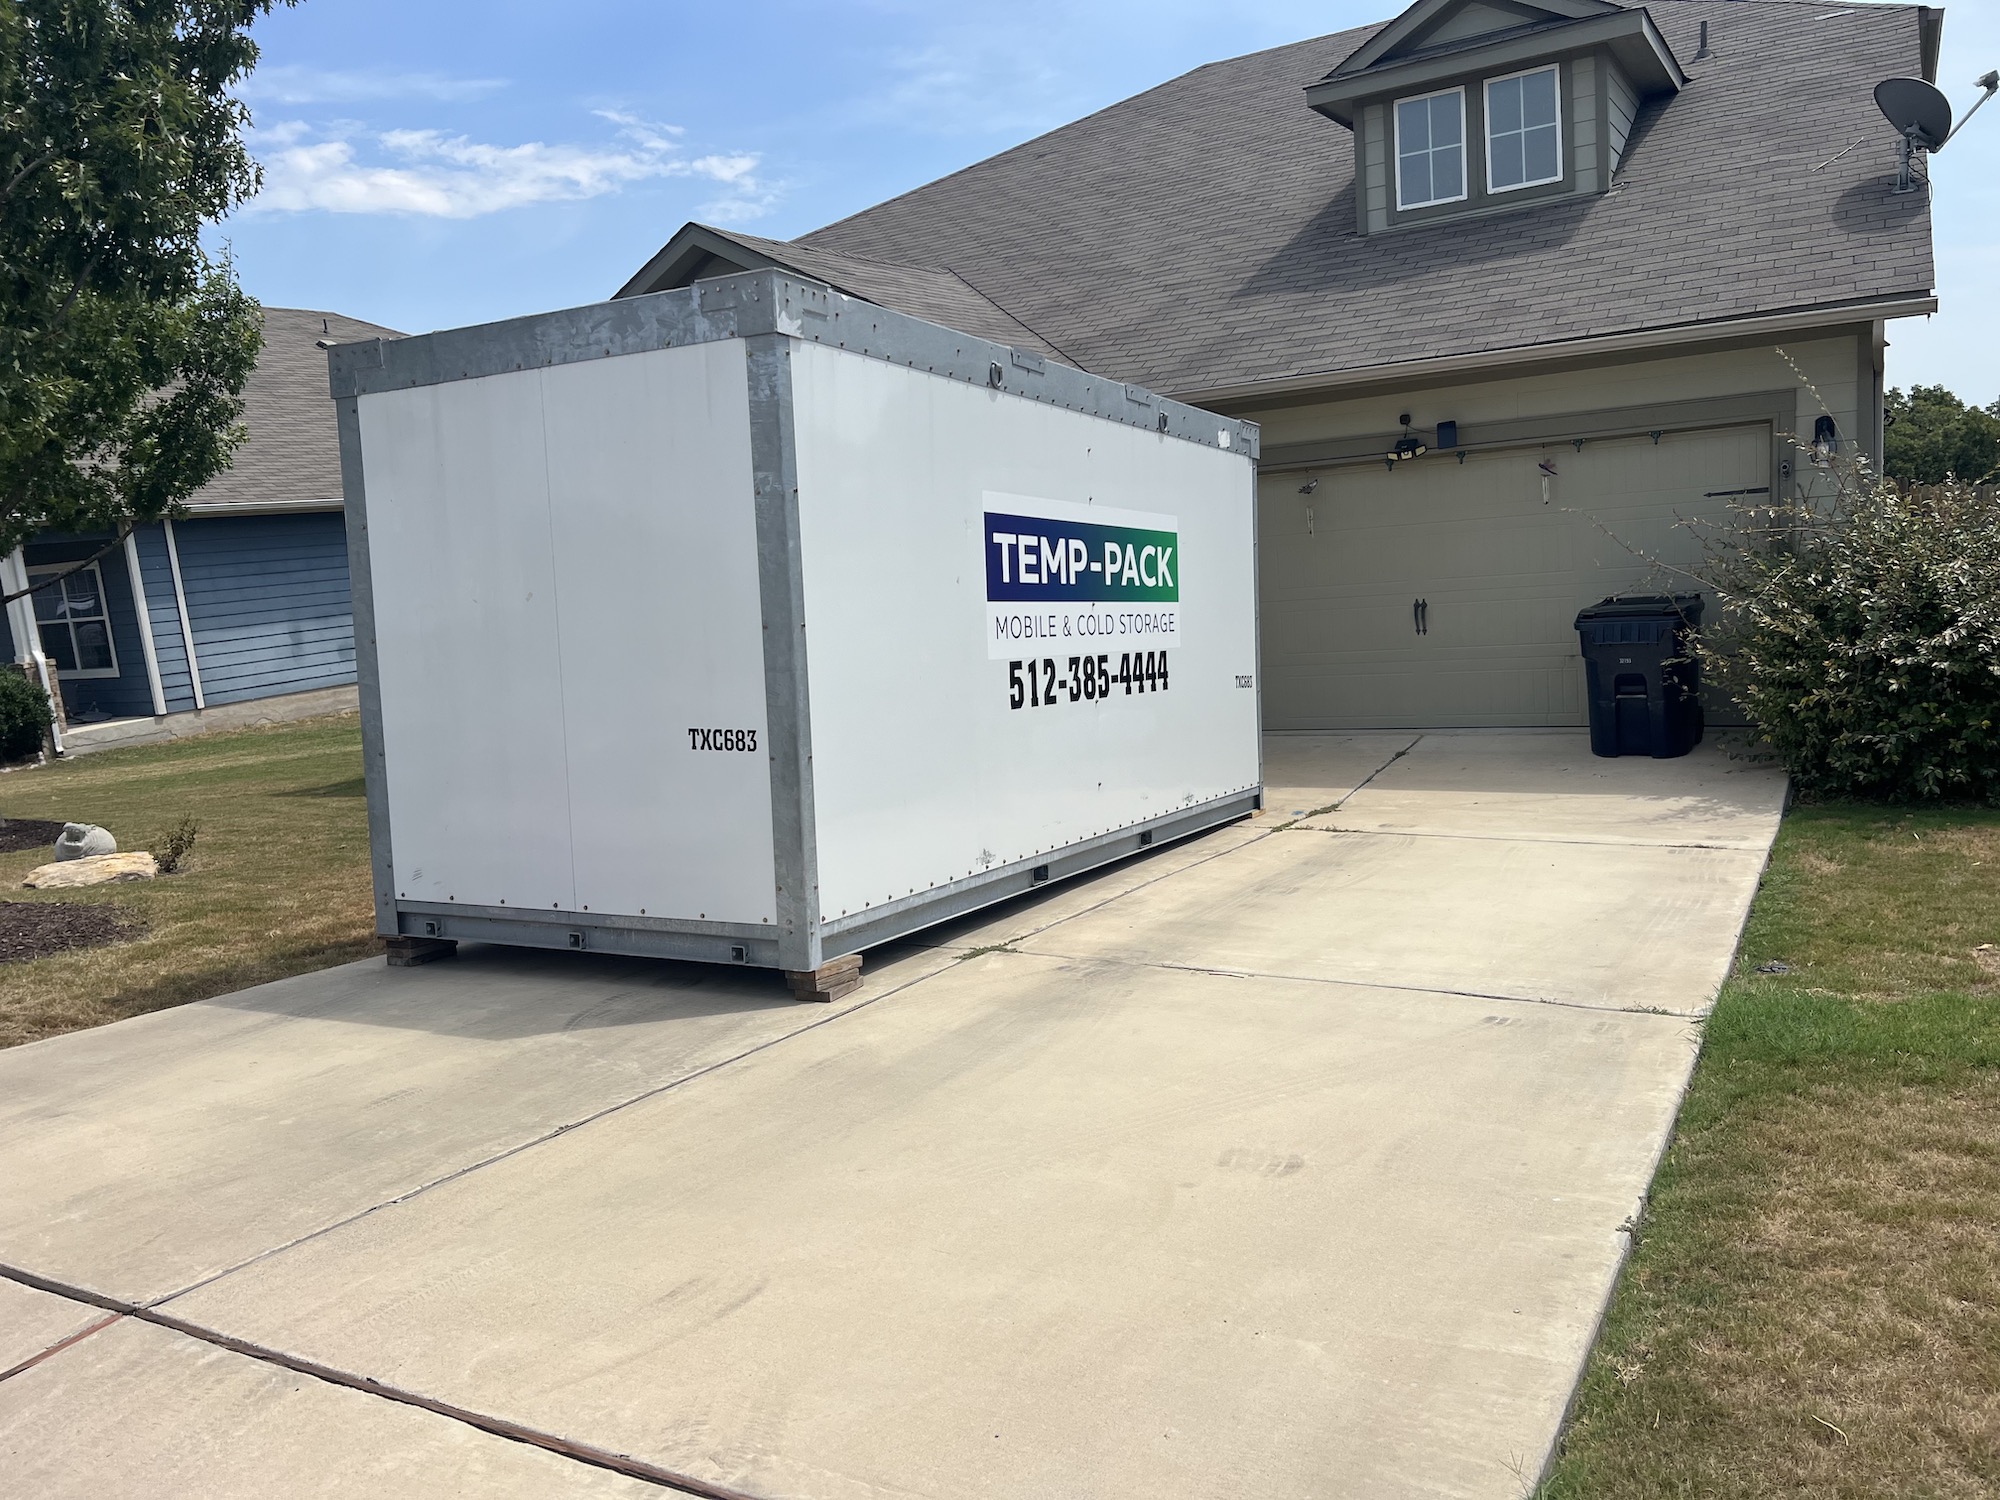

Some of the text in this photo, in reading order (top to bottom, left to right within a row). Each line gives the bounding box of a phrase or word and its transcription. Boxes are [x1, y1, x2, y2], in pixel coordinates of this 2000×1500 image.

[992, 532, 1174, 587] TEMP-PACK
[996, 613, 1175, 639] MOBILE & COLD STORAGE
[1009, 650, 1169, 710] 512-385-4444
[688, 728, 757, 752] TXC683
